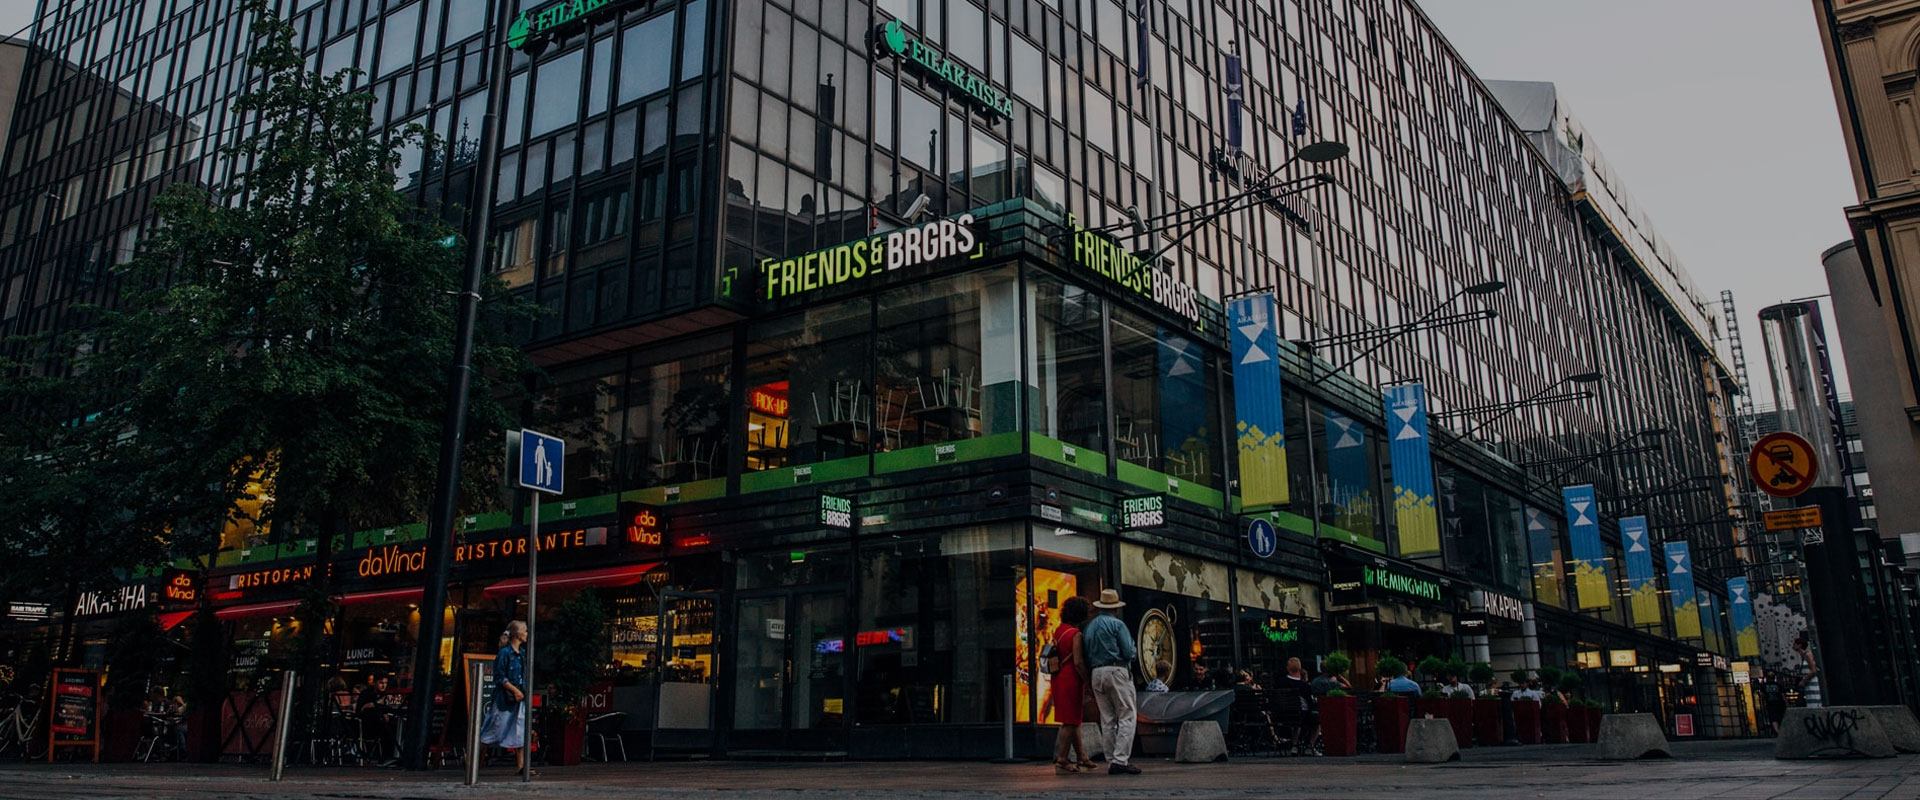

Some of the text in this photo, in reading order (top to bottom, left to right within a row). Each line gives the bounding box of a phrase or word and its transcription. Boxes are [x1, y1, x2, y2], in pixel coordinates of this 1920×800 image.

[912, 38, 1014, 120] EILAKAISLA
[767, 214, 976, 299] FRIENDS & BRGRS
[1073, 224, 1142, 292] FRIENDS
[1152, 266, 1200, 322] BRGRS
[756, 391, 788, 415] PICK-UP
[821, 495, 851, 513] FRIENDS
[1123, 496, 1163, 514] FRIENDS
[640, 510, 656, 527] da
[826, 511, 851, 528] BRGRS
[1123, 511, 1164, 528] & BRGRS
[633, 526, 662, 545] Vinci
[174, 573, 192, 587] da
[238, 561, 333, 588] RISTORAN
[167, 585, 195, 600] Vinci
[1376, 568, 1441, 601] HEMINGWAY'S
[1484, 591, 1525, 622] AIKAPIHA
[236, 656, 259, 667] LUNCH
[346, 648, 375, 659] LUNCH
